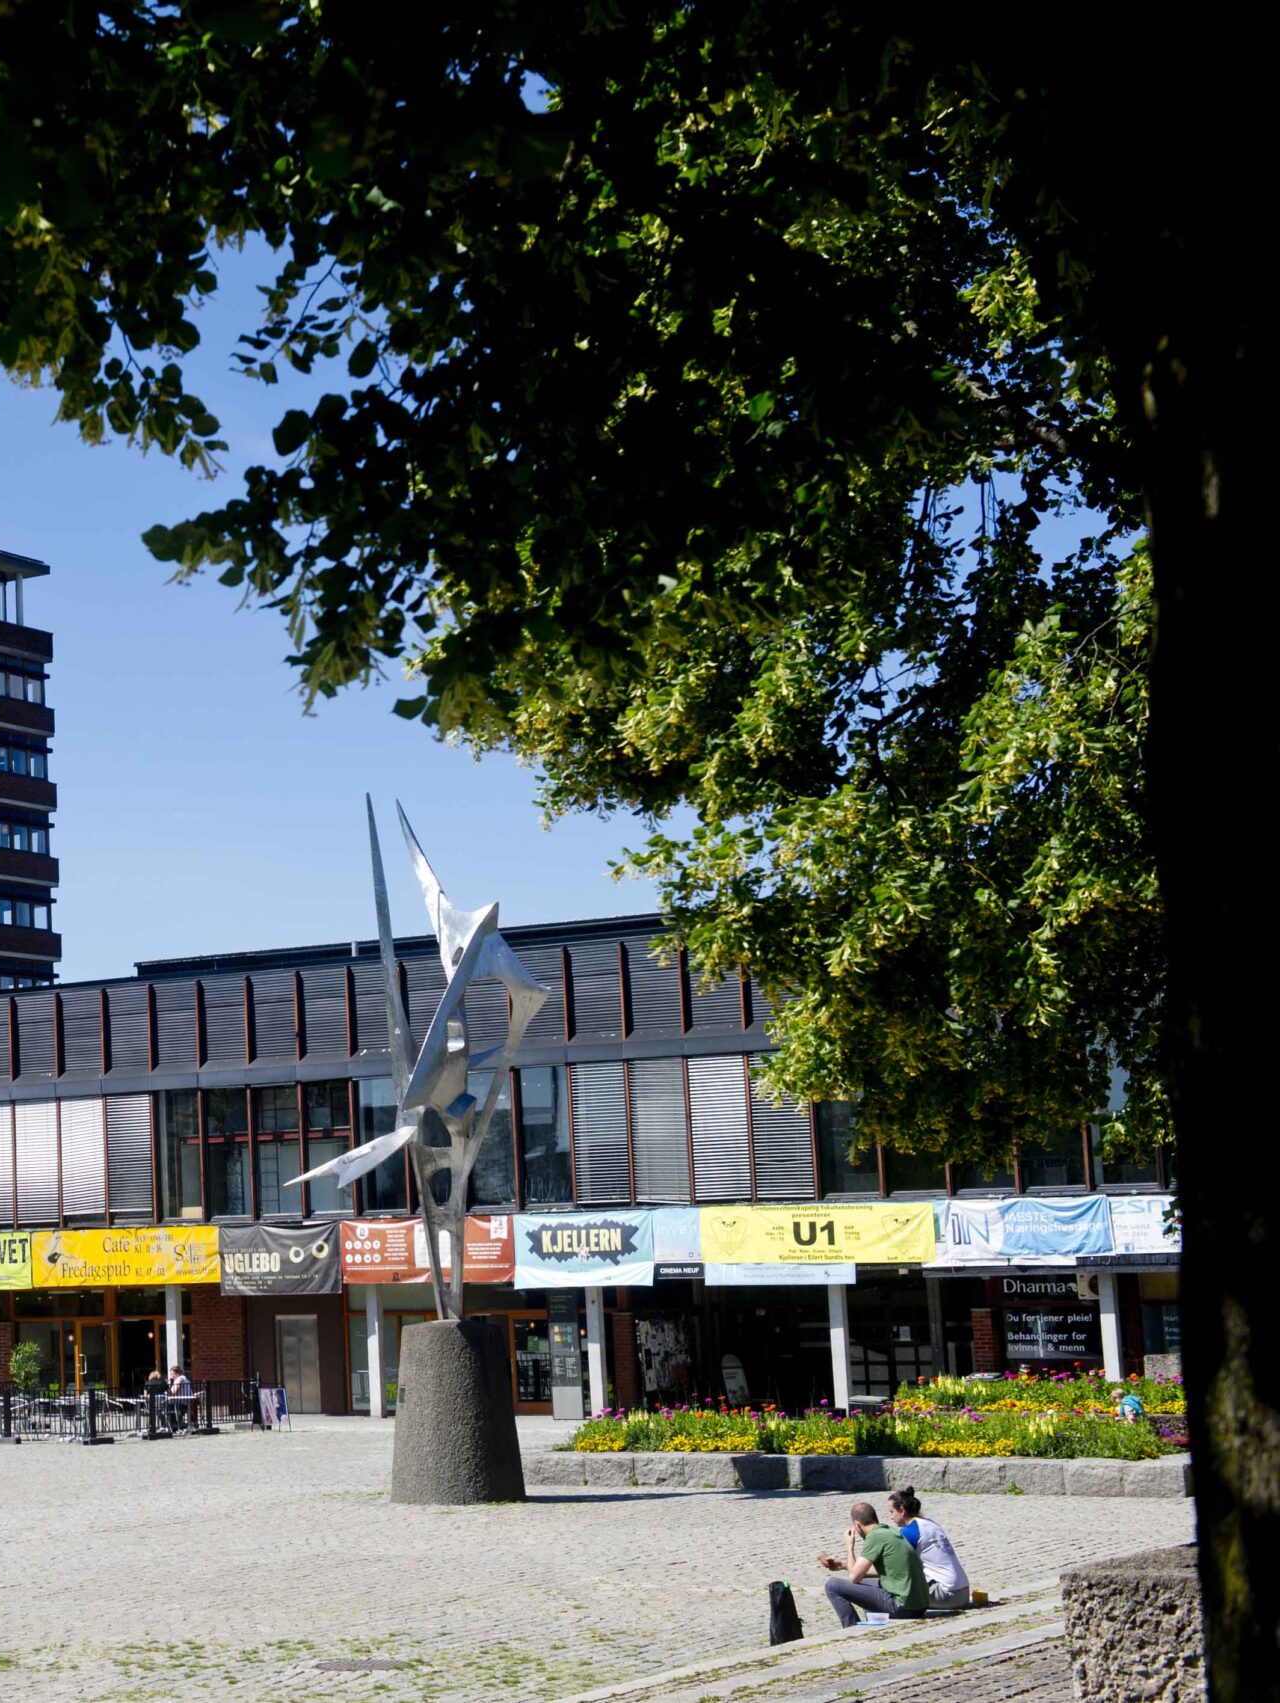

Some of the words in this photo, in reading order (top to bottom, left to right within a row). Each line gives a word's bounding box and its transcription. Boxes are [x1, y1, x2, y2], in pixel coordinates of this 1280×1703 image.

[541, 1228, 622, 1253] KJELLERN
[792, 1220, 835, 1246] U1
[61, 1260, 131, 1280] Fredagspub
[223, 1251, 281, 1274] UGLEBO
[1003, 1278, 1066, 1294] Dharma
[1007, 1314, 1019, 1322] Du
[1022, 1313, 1064, 1323] fortjener
[1067, 1313, 1093, 1324] pleie!
[1007, 1331, 1068, 1343] Behandlinger
[1071, 1331, 1087, 1340] for
[1059, 1344, 1085, 1352] menn
